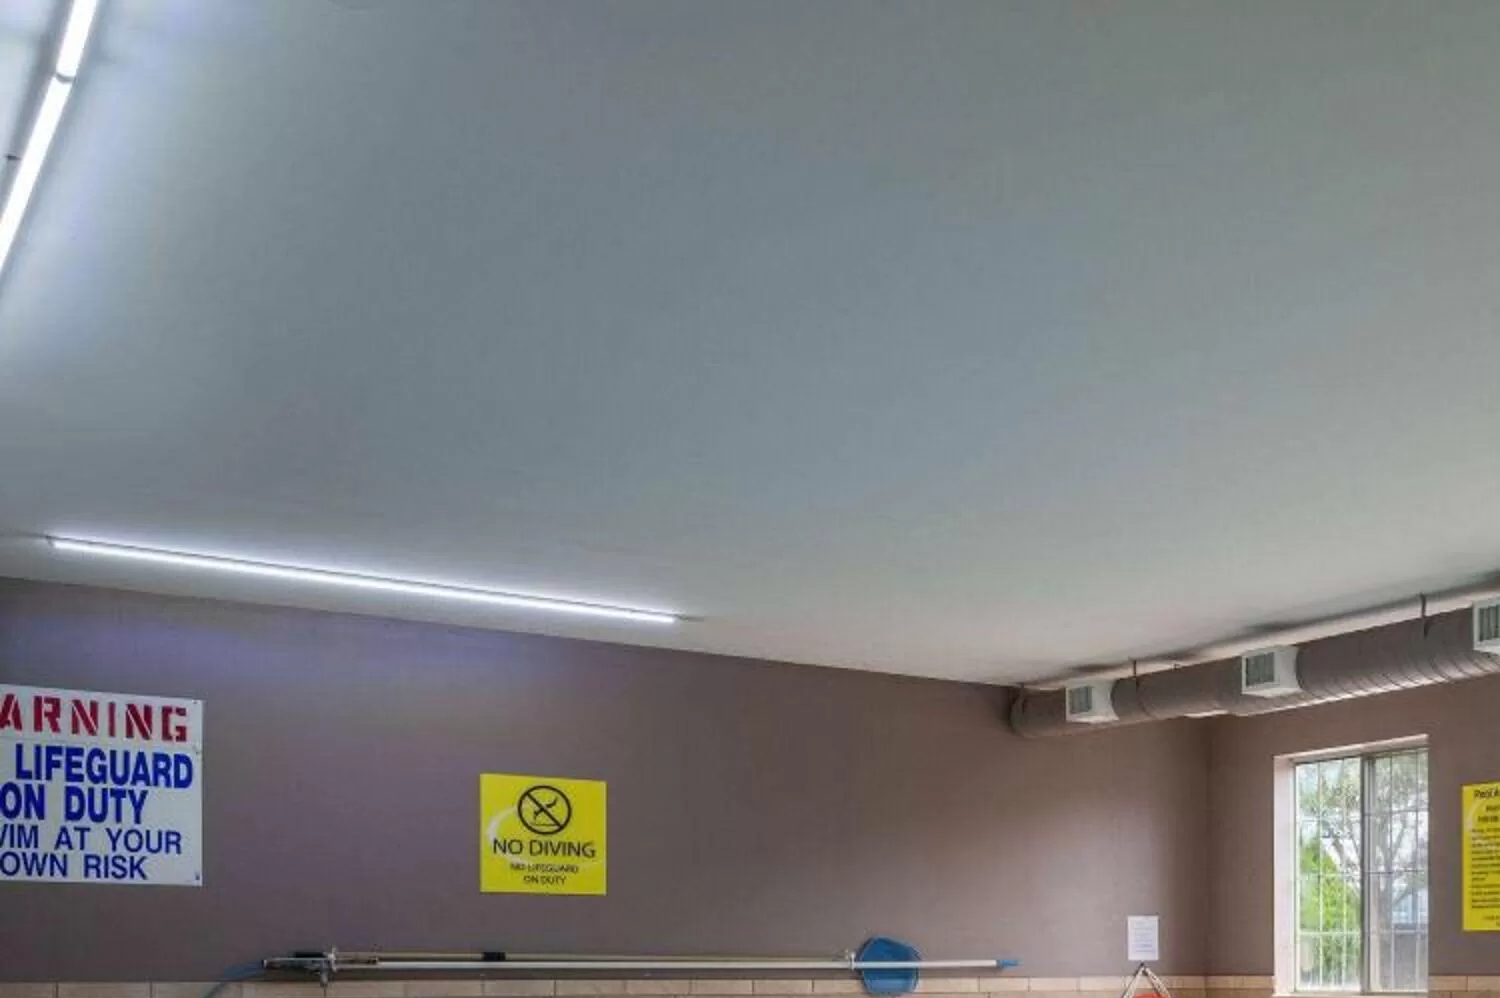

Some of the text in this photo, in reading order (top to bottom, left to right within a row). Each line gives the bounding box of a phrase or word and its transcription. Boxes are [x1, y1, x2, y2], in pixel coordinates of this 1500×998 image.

[0, 693, 188, 742] ARNING
[15, 743, 193, 789] LIFEGUARD
[0, 782, 149, 824] ON DUTY
[0, 823, 182, 855] IM AT YOUR
[493, 837, 597, 859] NO DIVING
[0, 851, 148, 880] OWN RISK
[523, 874, 567, 885] ON DUTY
